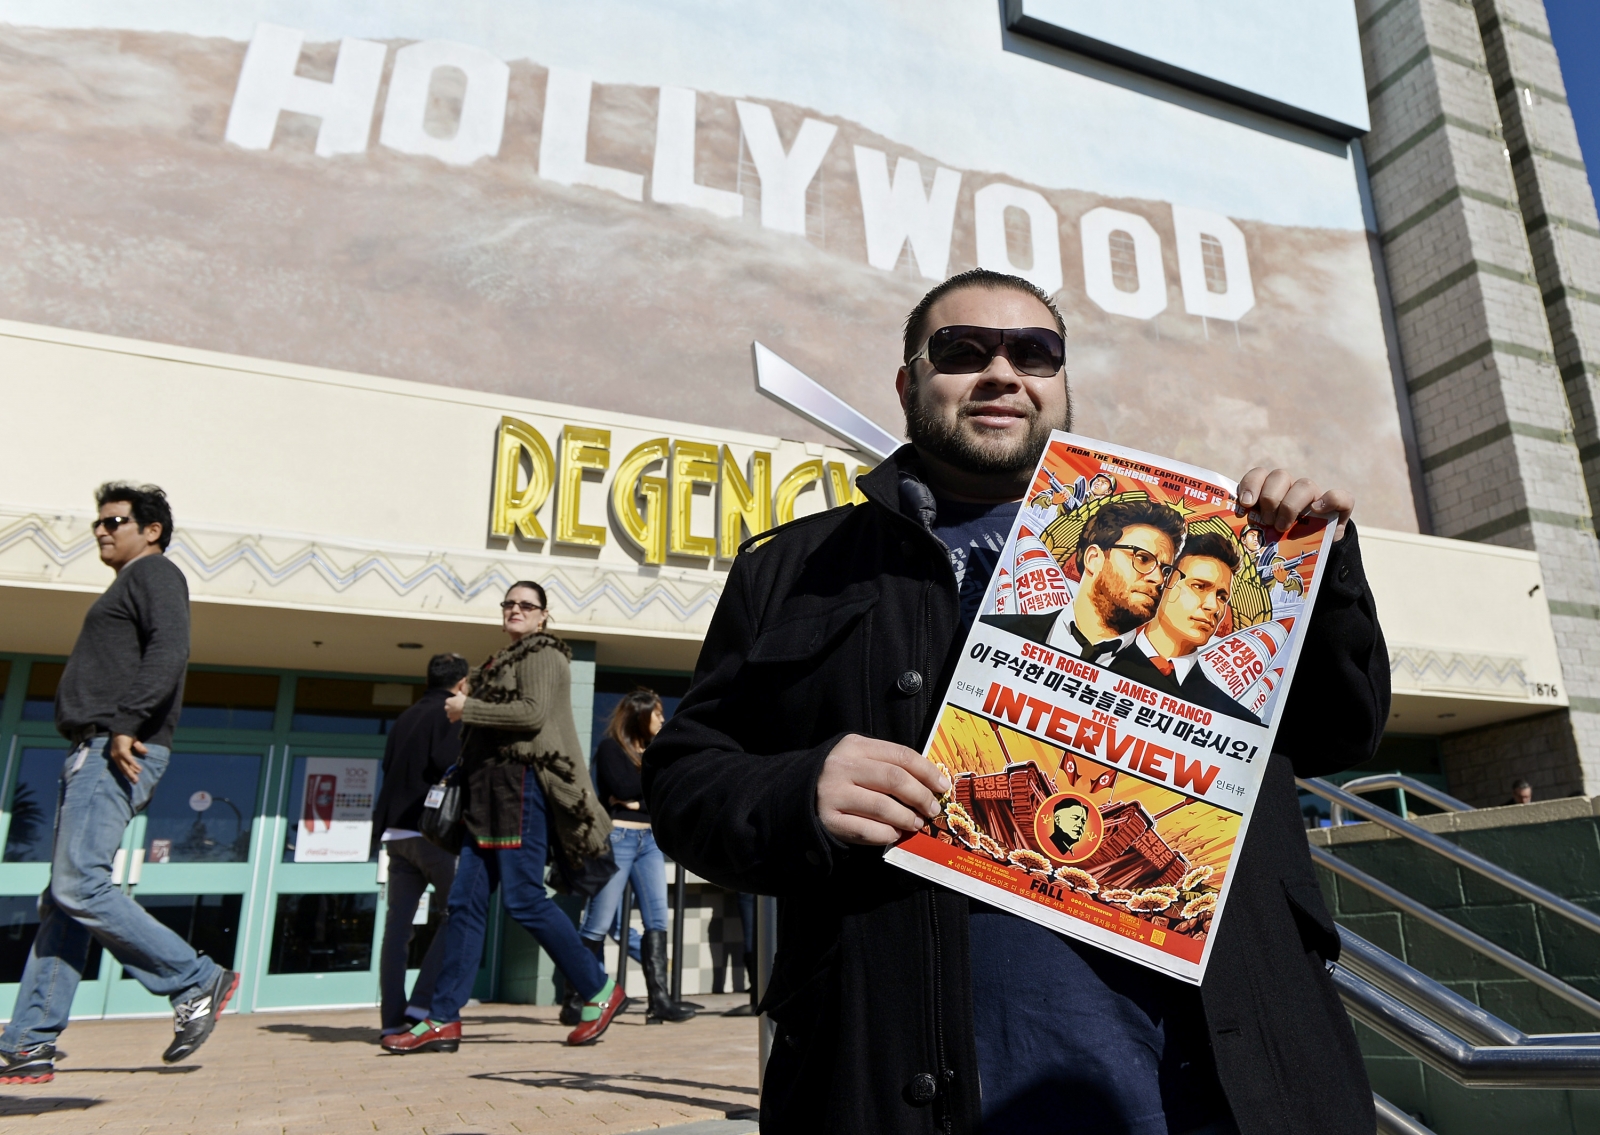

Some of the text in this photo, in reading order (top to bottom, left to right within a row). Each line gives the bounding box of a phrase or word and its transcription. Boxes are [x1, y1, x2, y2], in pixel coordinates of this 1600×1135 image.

[221, 22, 1255, 322] HOLLYWOOD
[1066, 446, 1090, 457] FROM
[1093, 452, 1109, 461] THE
[1112, 457, 1151, 473] WESTERN
[1154, 469, 1202, 489] CAPITALIST
[1205, 485, 1225, 497] PIGS
[1100, 463, 1160, 485] NEIGHBORS
[1162, 481, 1180, 491] AND
[1184, 486, 1208, 501] THIS
[1211, 495, 1223, 506] IS
[1225, 501, 1245, 516] THE
[1249, 511, 1266, 526] EN
[1016, 567, 1065, 599] 전쟁은
[1021, 642, 1213, 726] SETH ROGEN JAMES FRANCO
[1217, 637, 1263, 686] 전쟁은
[956, 680, 985, 698] 인터뷰
[970, 642, 1258, 764] 이 무식한 미국놈들을 믿지 마십시오!
[981, 681, 1221, 796] INTERVIEW
[1091, 709, 1119, 728] THE
[973, 775, 1008, 791] 전쟁은
[1216, 779, 1246, 797] 인터뷰
[1030, 879, 1063, 902] FALL
